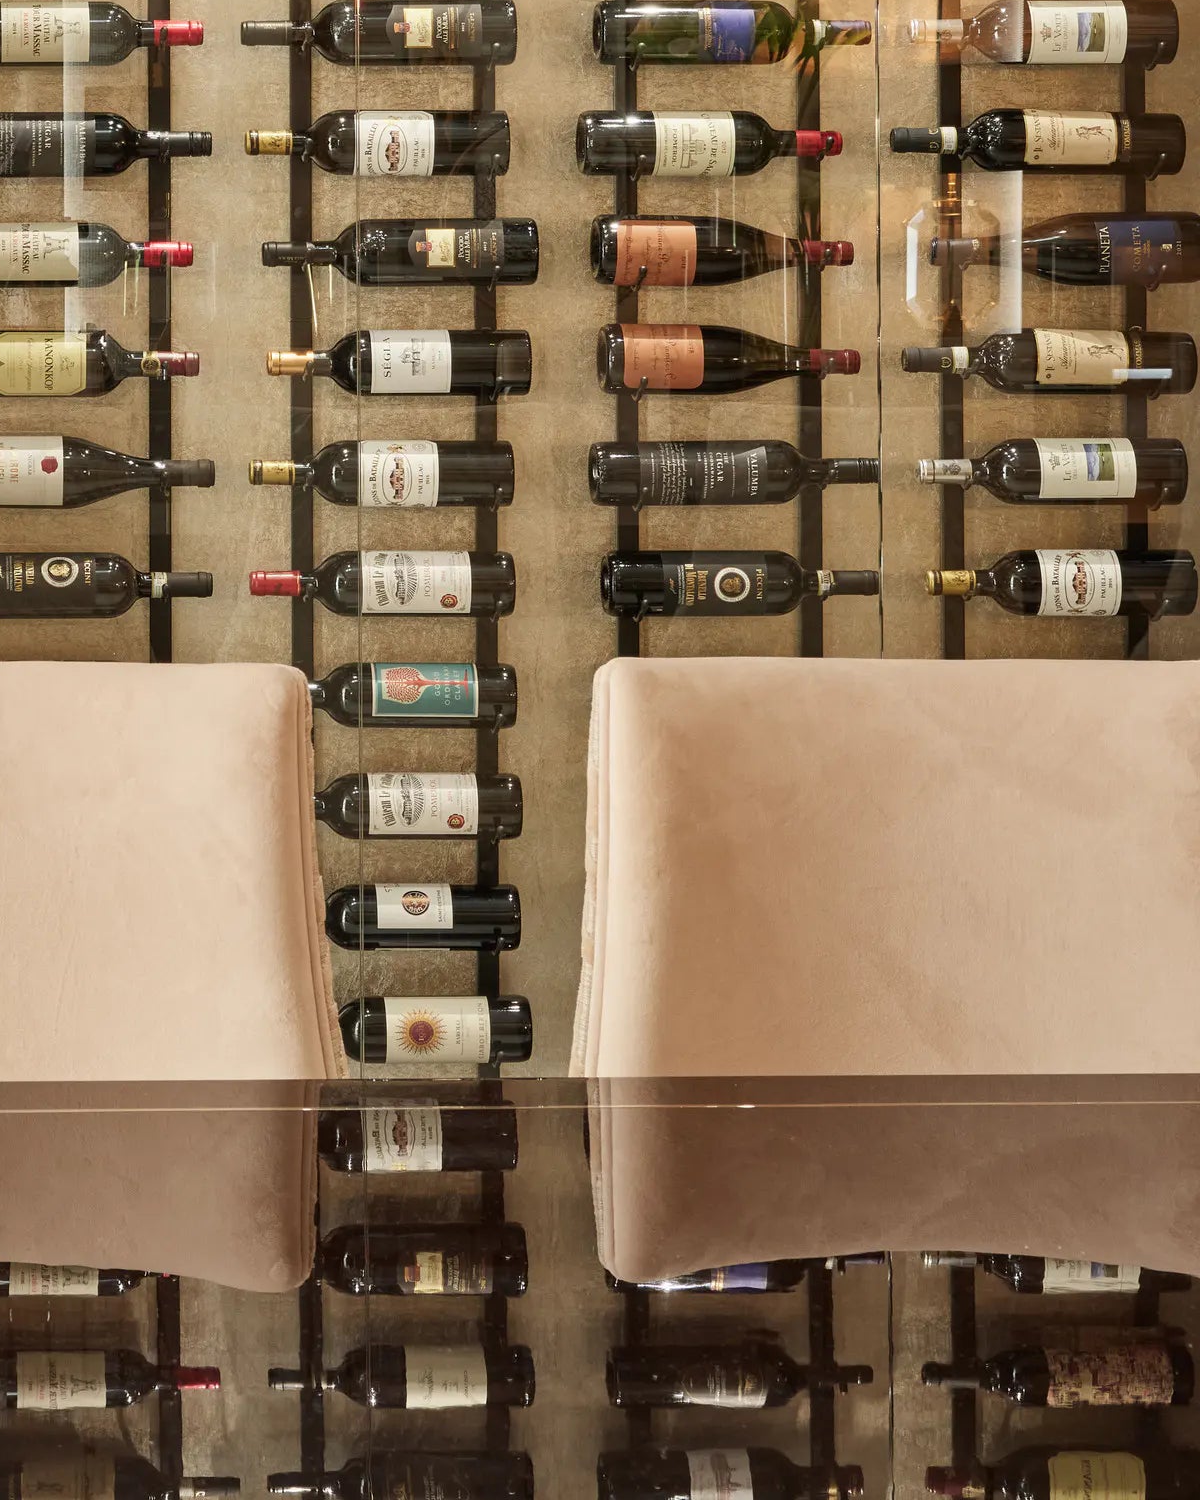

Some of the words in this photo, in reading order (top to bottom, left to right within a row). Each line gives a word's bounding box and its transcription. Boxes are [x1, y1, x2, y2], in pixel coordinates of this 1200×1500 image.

[33, 24, 41, 56] MASSAC
[1054, 14, 1062, 38] VOLTE
[1052, 44, 1060, 52] LE
[365, 124, 378, 155] BATAILLEY
[710, 148, 718, 156] DE
[22, 241, 30, 274] MASSAC
[1099, 226, 1110, 273] PLANETA
[1132, 226, 1142, 271] COMETA
[44, 338, 54, 390] KANONKOP
[382, 337, 391, 378] SÉGLA
[370, 450, 382, 482] BATAILLEY
[716, 452, 724, 482] CIGAR
[750, 452, 758, 496] YALUMBA
[1063, 472, 1071, 481] LE
[698, 570, 708, 600] BRUNELLO
[1052, 555, 1062, 585] BATAILLEY
[686, 572, 697, 606] MONTALCINO
[1054, 594, 1063, 612] LIONS
